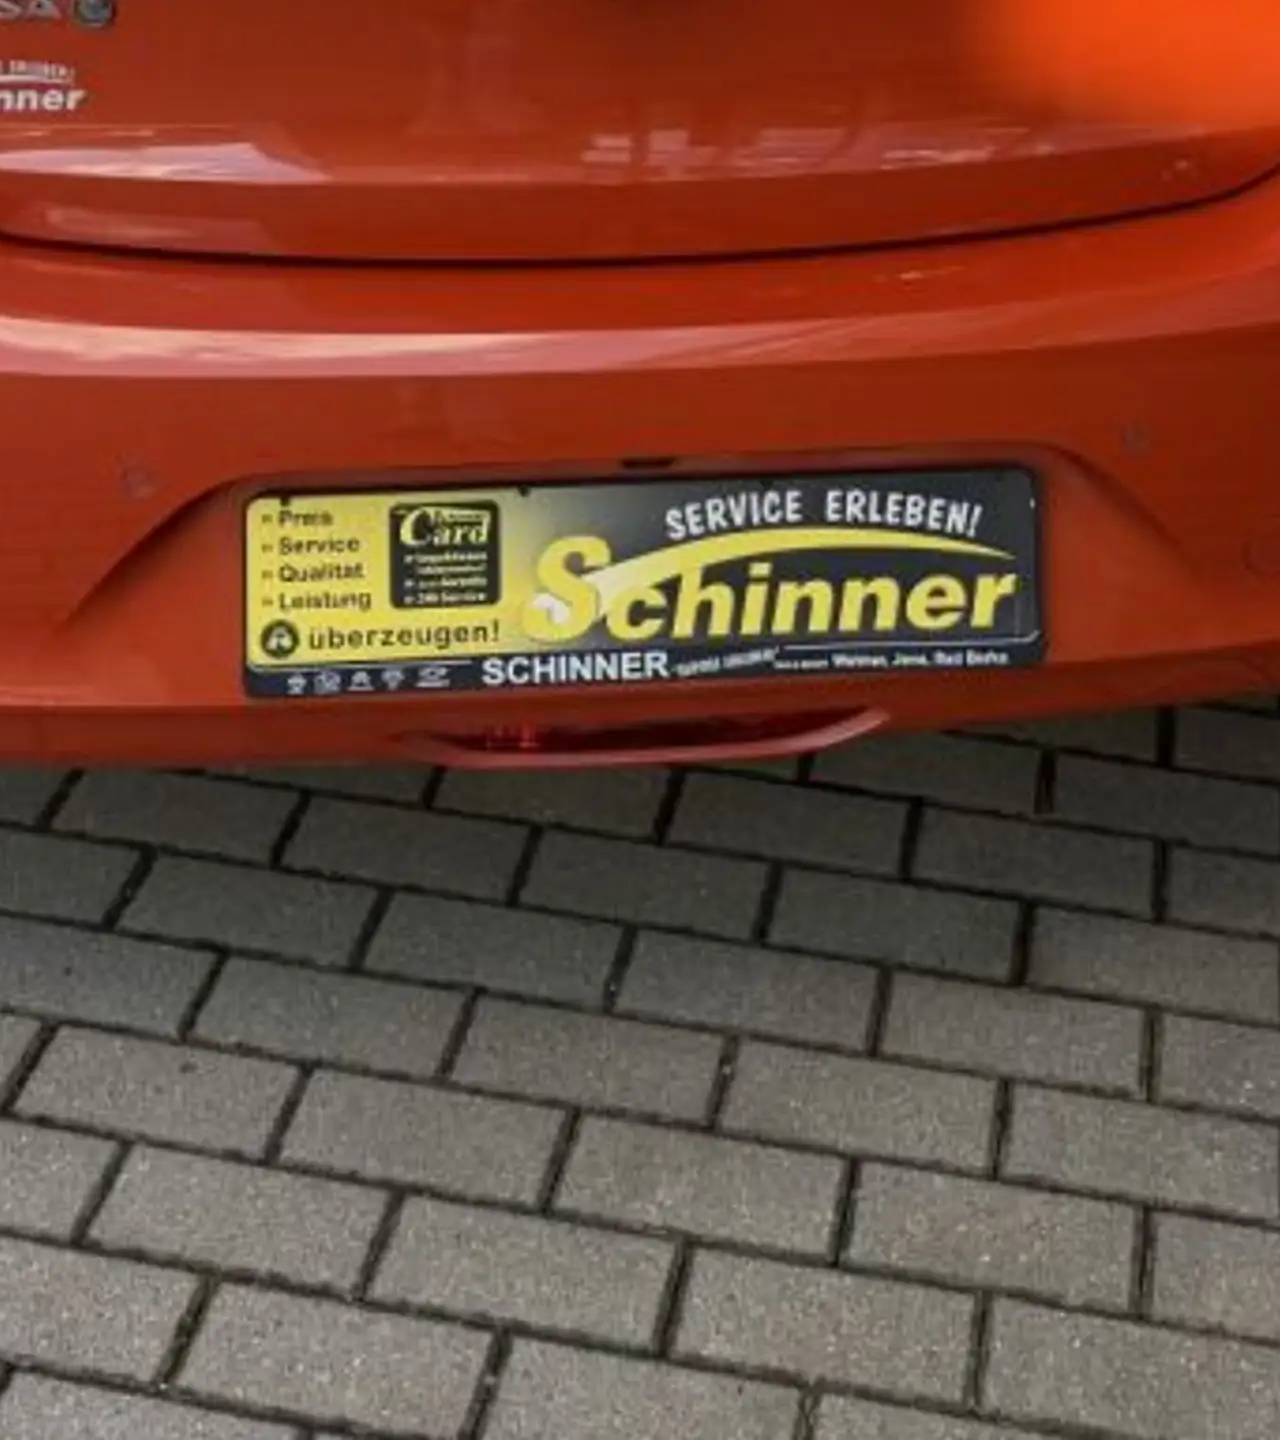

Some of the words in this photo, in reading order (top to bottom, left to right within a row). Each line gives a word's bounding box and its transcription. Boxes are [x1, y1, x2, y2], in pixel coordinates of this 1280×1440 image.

[400, 506, 491, 546] Card
[666, 490, 802, 540] SERVICE
[826, 490, 982, 538] ERLEBEN!
[279, 536, 360, 556] Service
[279, 591, 372, 611] Leistung
[523, 535, 1017, 642] Schinner
[308, 619, 500, 651] überzeugen!
[482, 651, 669, 685] SCHINNER
